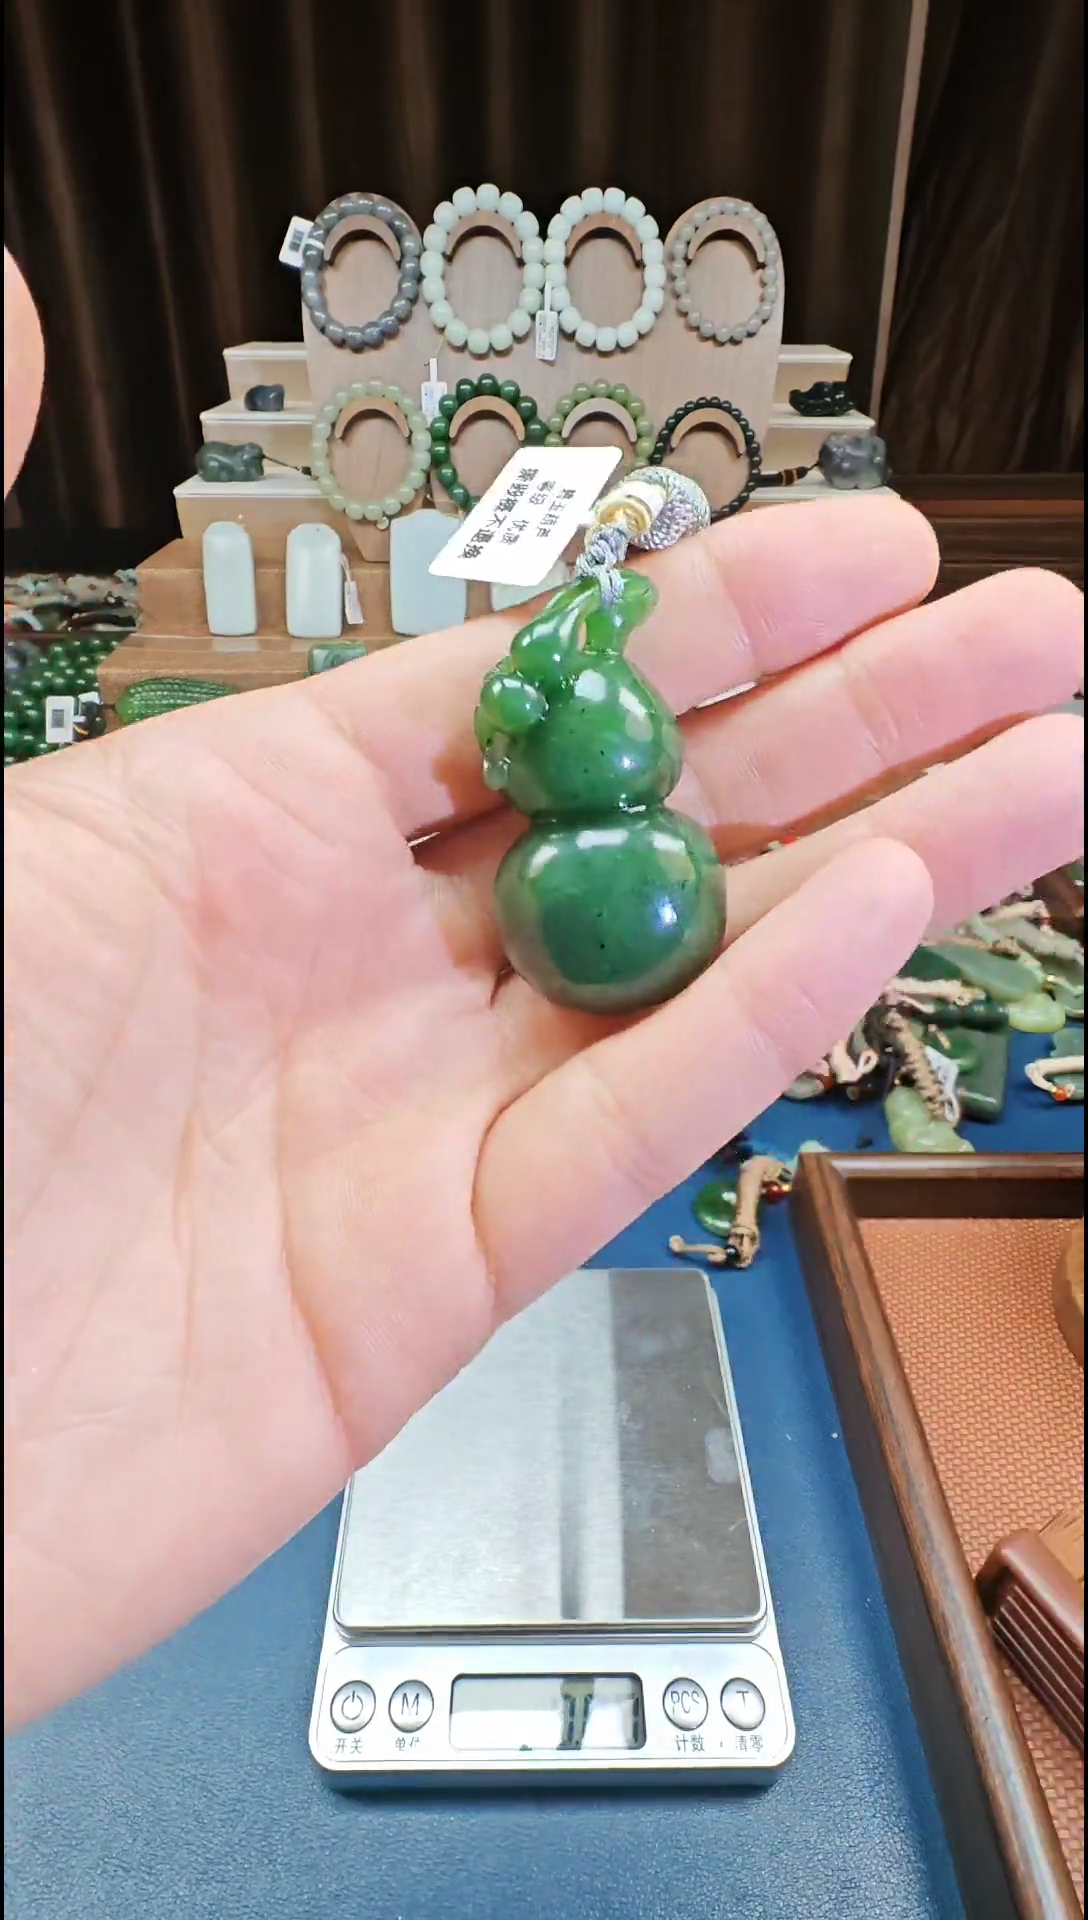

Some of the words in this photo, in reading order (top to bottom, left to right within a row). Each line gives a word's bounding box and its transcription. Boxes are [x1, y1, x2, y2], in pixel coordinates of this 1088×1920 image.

[401, 1692, 420, 1716] M
[670, 1690, 700, 1715] PCS
[335, 1737, 362, 1755] 开关
[675, 1733, 706, 1754] 计数
[735, 1734, 764, 1753] 清零
